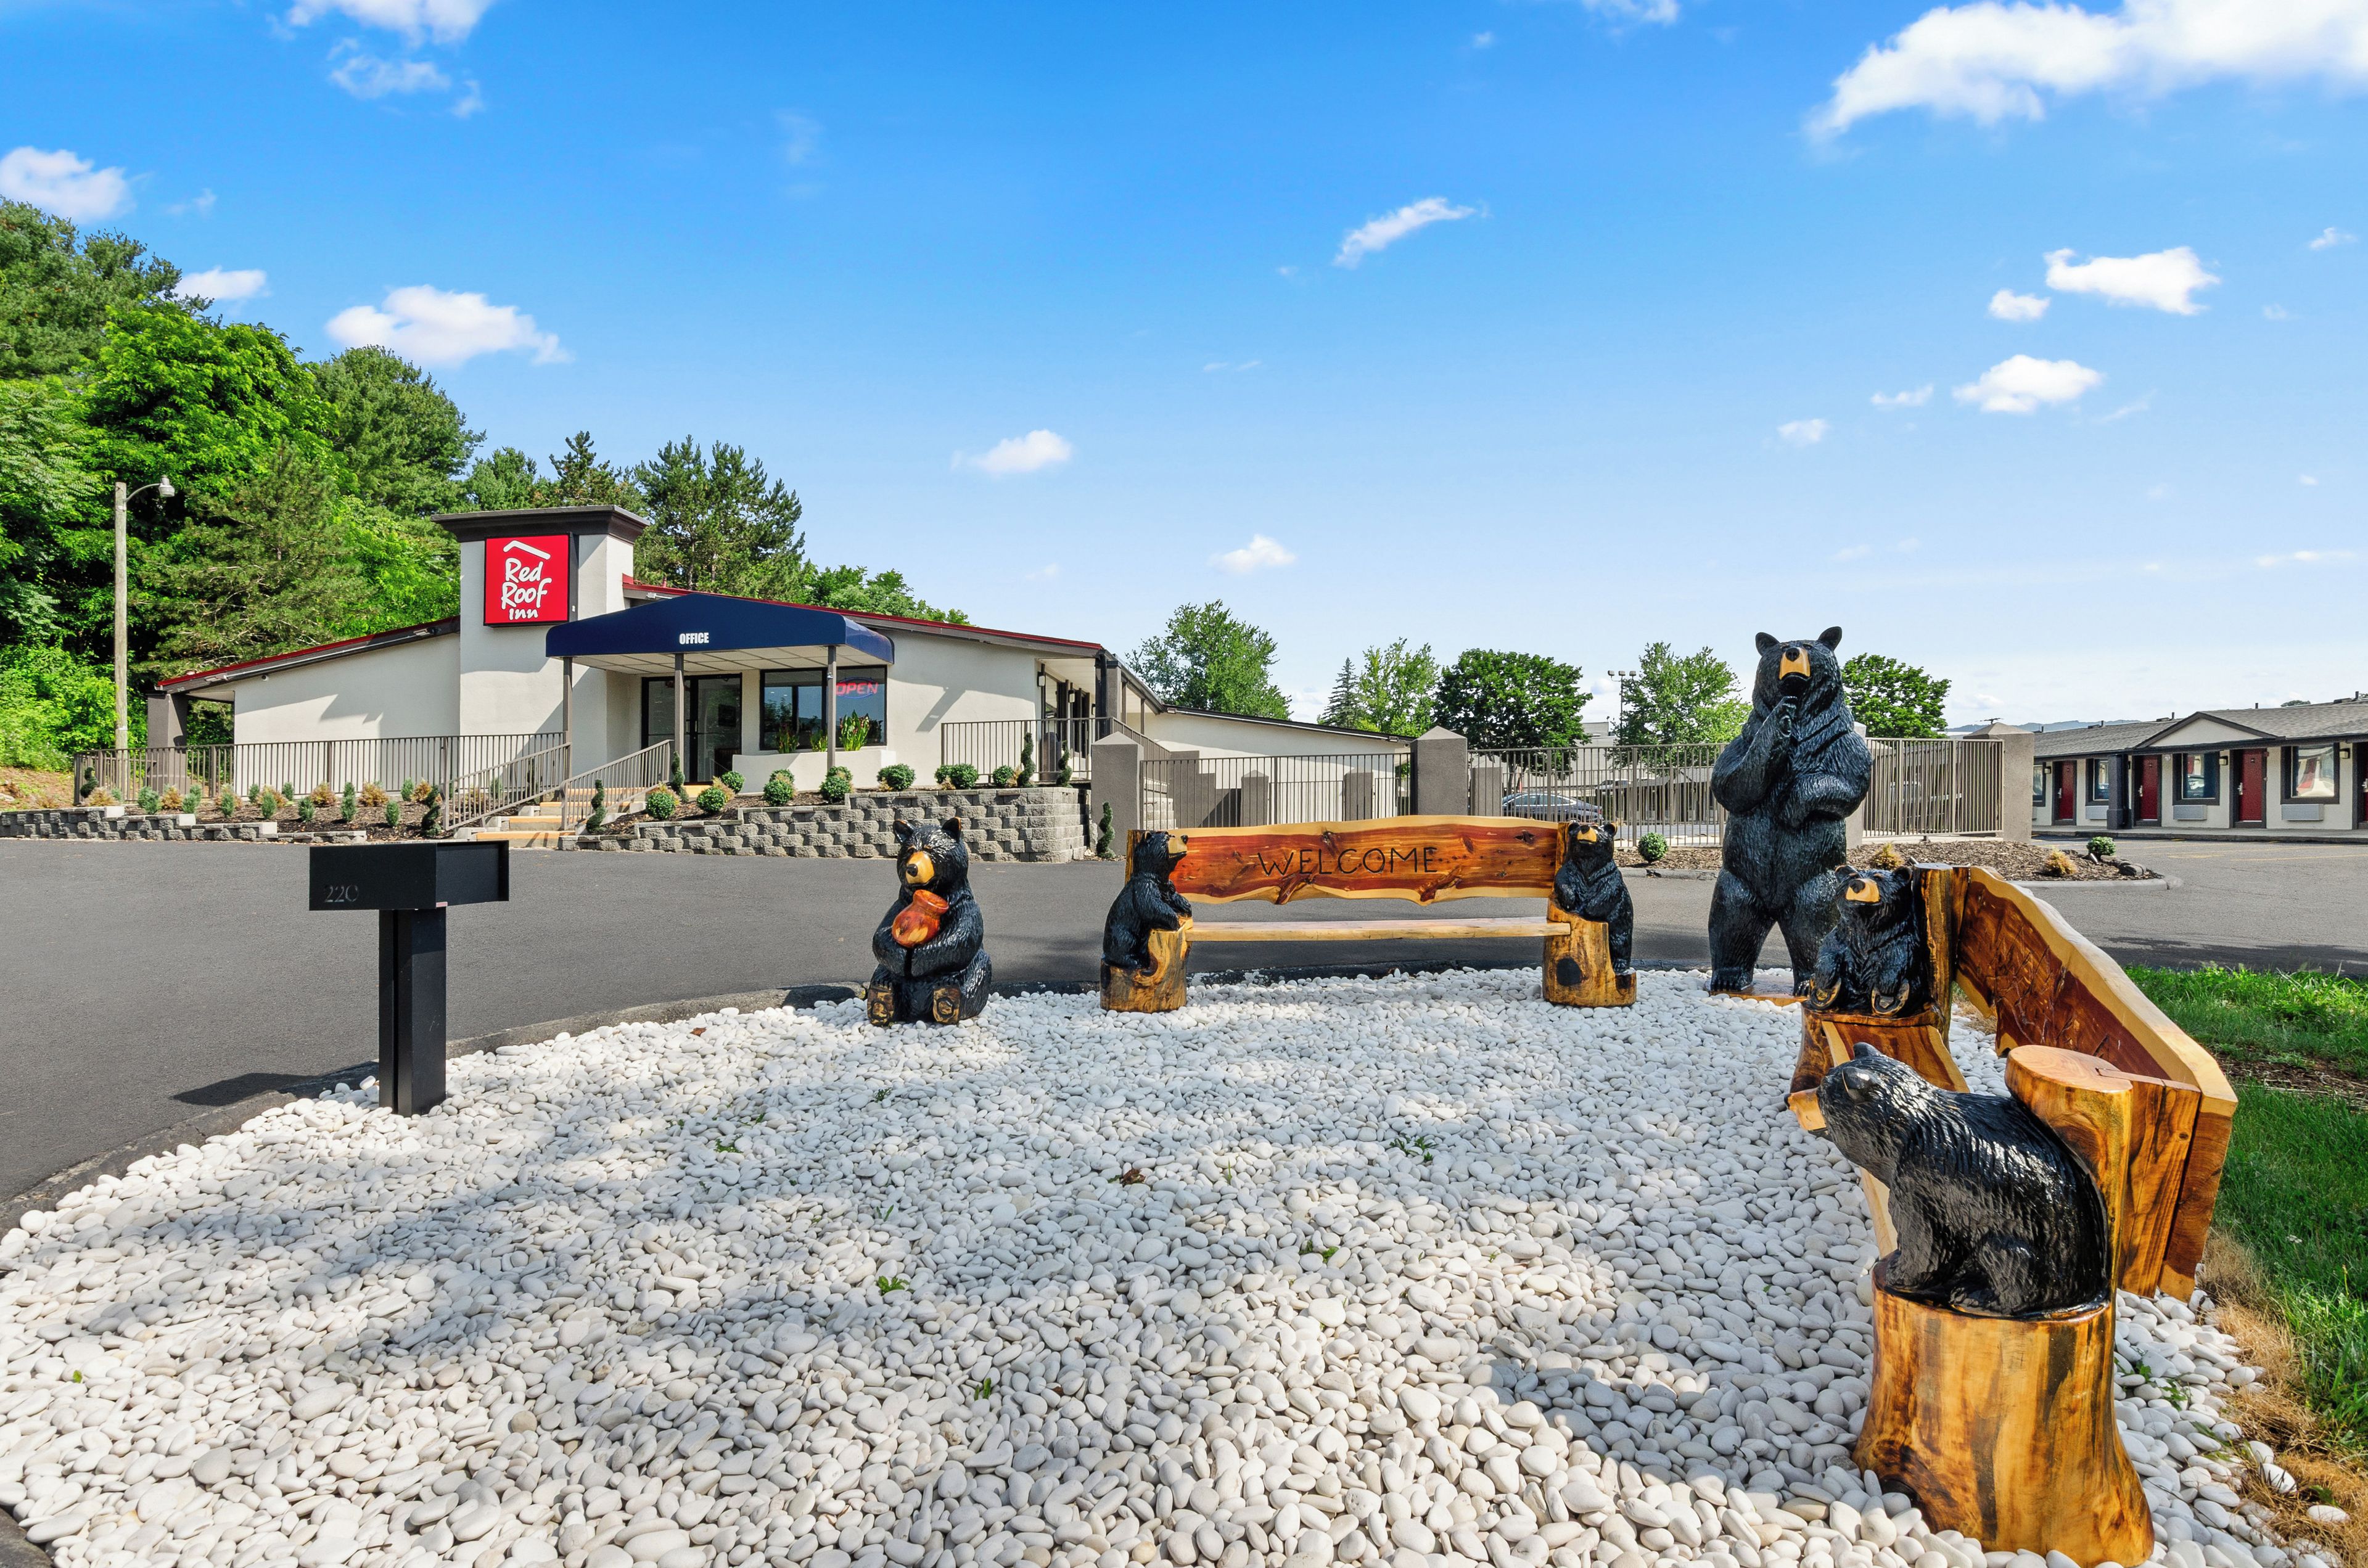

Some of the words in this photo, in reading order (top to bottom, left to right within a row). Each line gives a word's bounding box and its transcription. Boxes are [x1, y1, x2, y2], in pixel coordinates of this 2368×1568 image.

[505, 557, 544, 583] Red
[501, 578, 553, 610] Roof
[679, 632, 709, 644] OFFICE
[836, 681, 878, 696] OPEN
[1257, 847, 1438, 876] WELCOME
